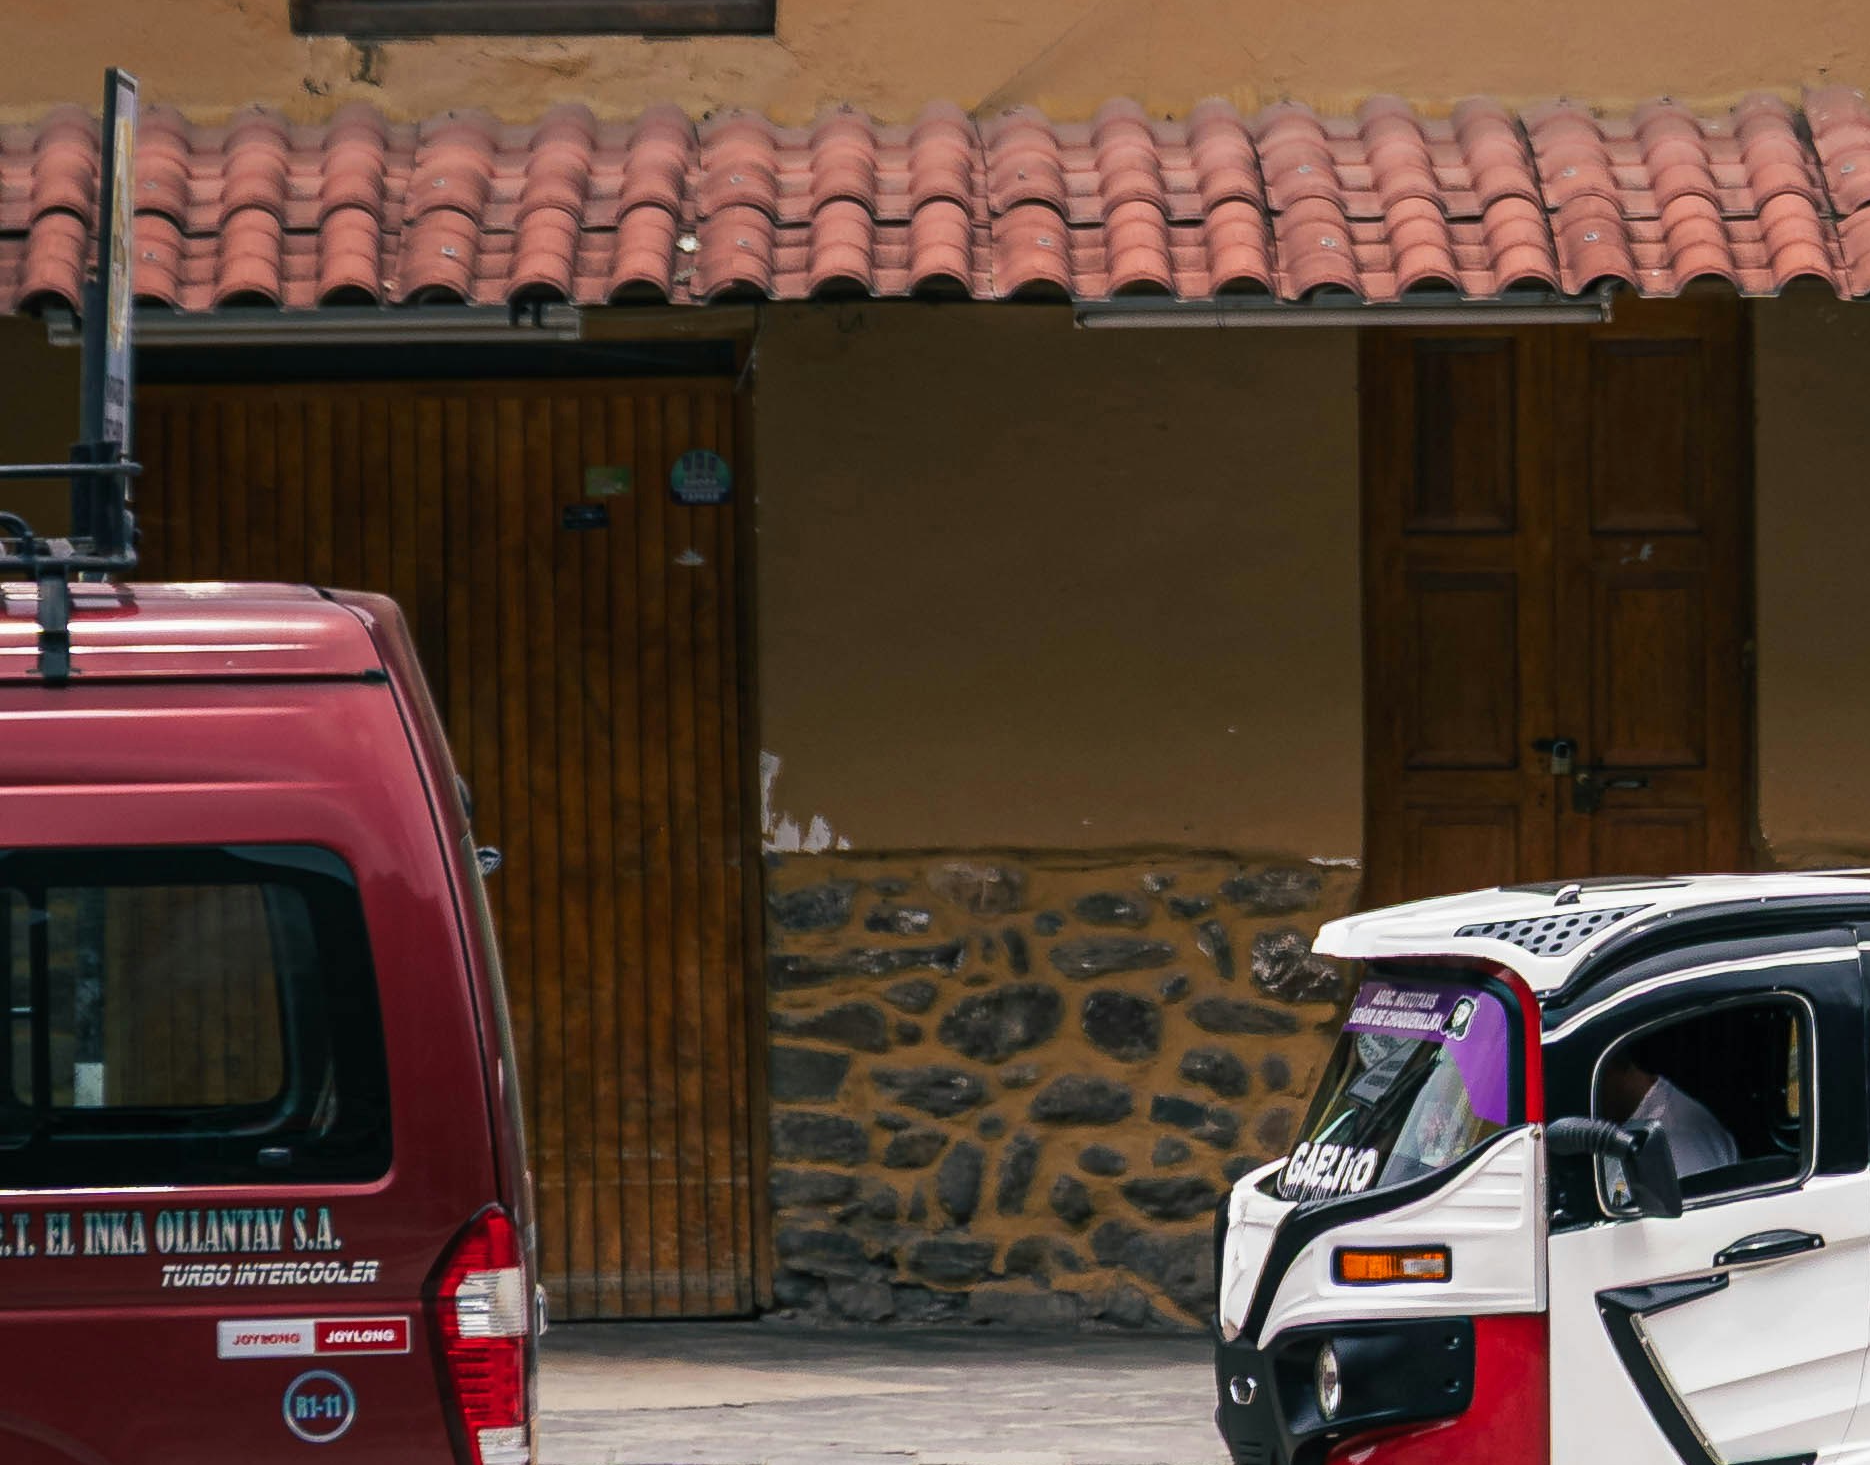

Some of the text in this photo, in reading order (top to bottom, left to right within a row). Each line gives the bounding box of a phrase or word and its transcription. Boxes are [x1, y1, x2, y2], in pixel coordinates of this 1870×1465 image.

[44, 1212, 76, 1256] EL
[83, 1210, 147, 1256] INKA
[155, 1208, 285, 1254] OLLANTAY
[292, 1206, 342, 1251] S.A.
[161, 1260, 380, 1288] TURBO INTERCOOLER
[325, 1329, 397, 1344] JOYLONG
